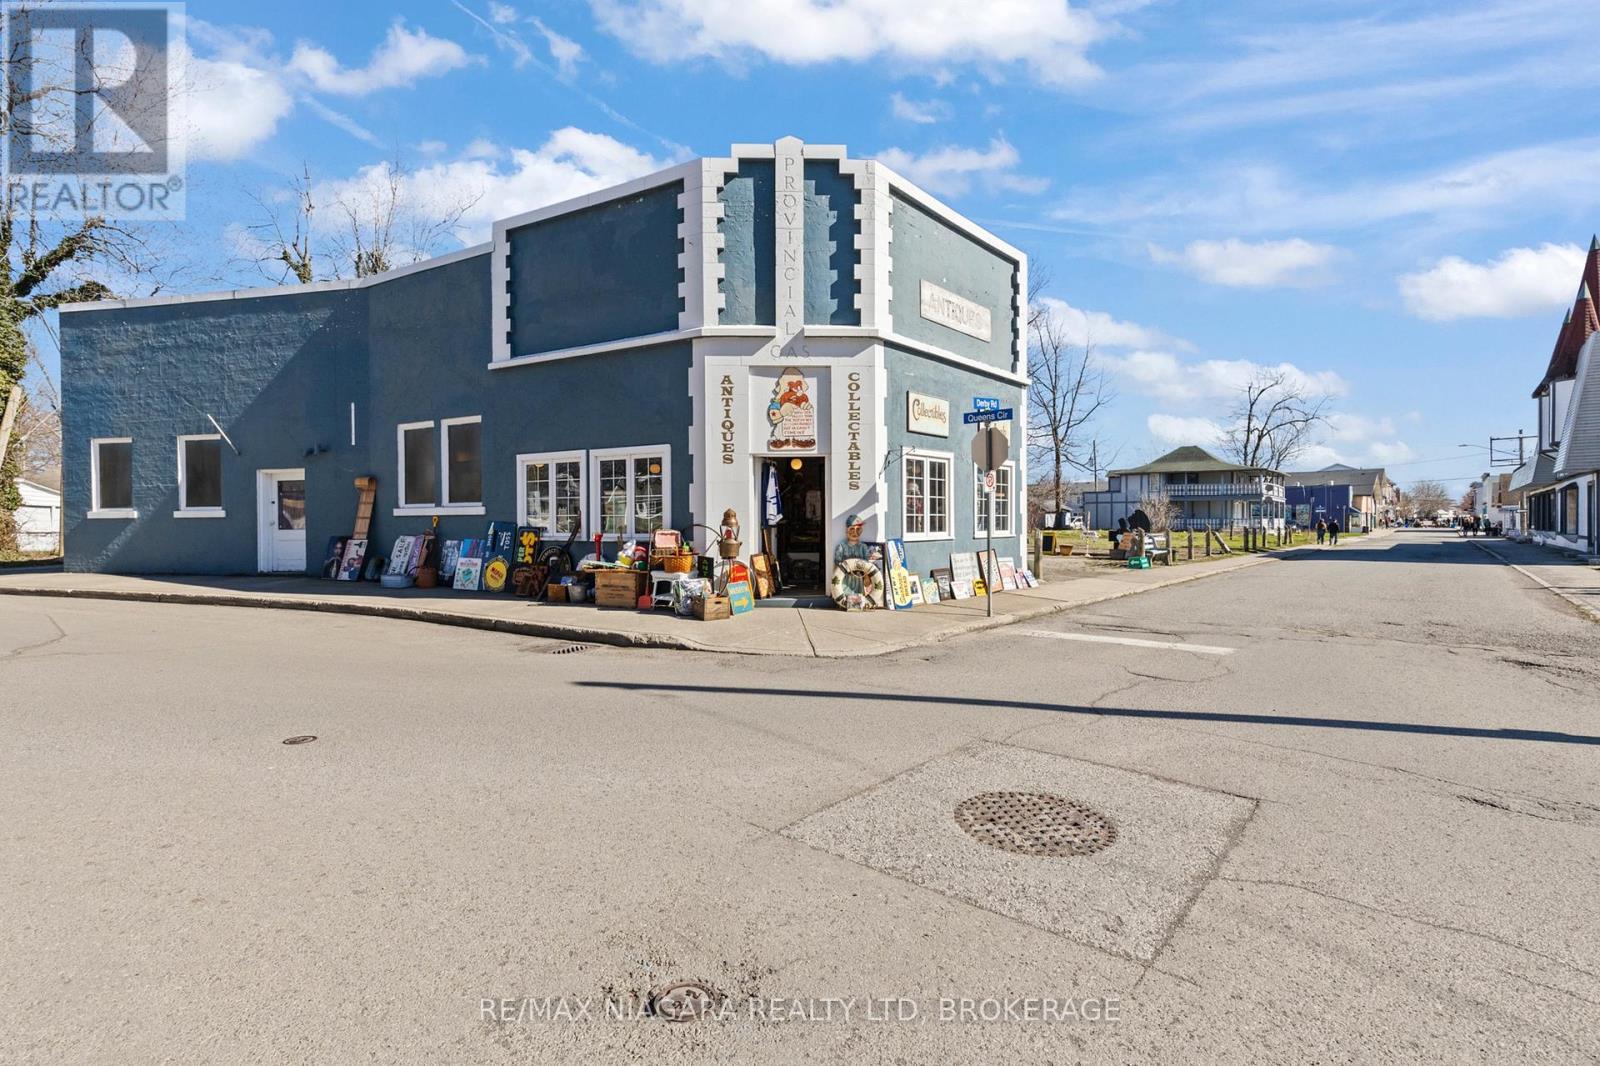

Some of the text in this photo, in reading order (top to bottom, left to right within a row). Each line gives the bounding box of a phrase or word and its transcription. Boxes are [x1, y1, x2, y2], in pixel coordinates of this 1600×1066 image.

[783, 157, 797, 336] PROVINCIAL
[769, 344, 811, 359] GAS
[720, 374, 735, 465] ANTIQUES
[967, 411, 1008, 422] Queens Cir
[976, 399, 998, 408] Derby Rd
[847, 372, 861, 491] COLLECTABLES
